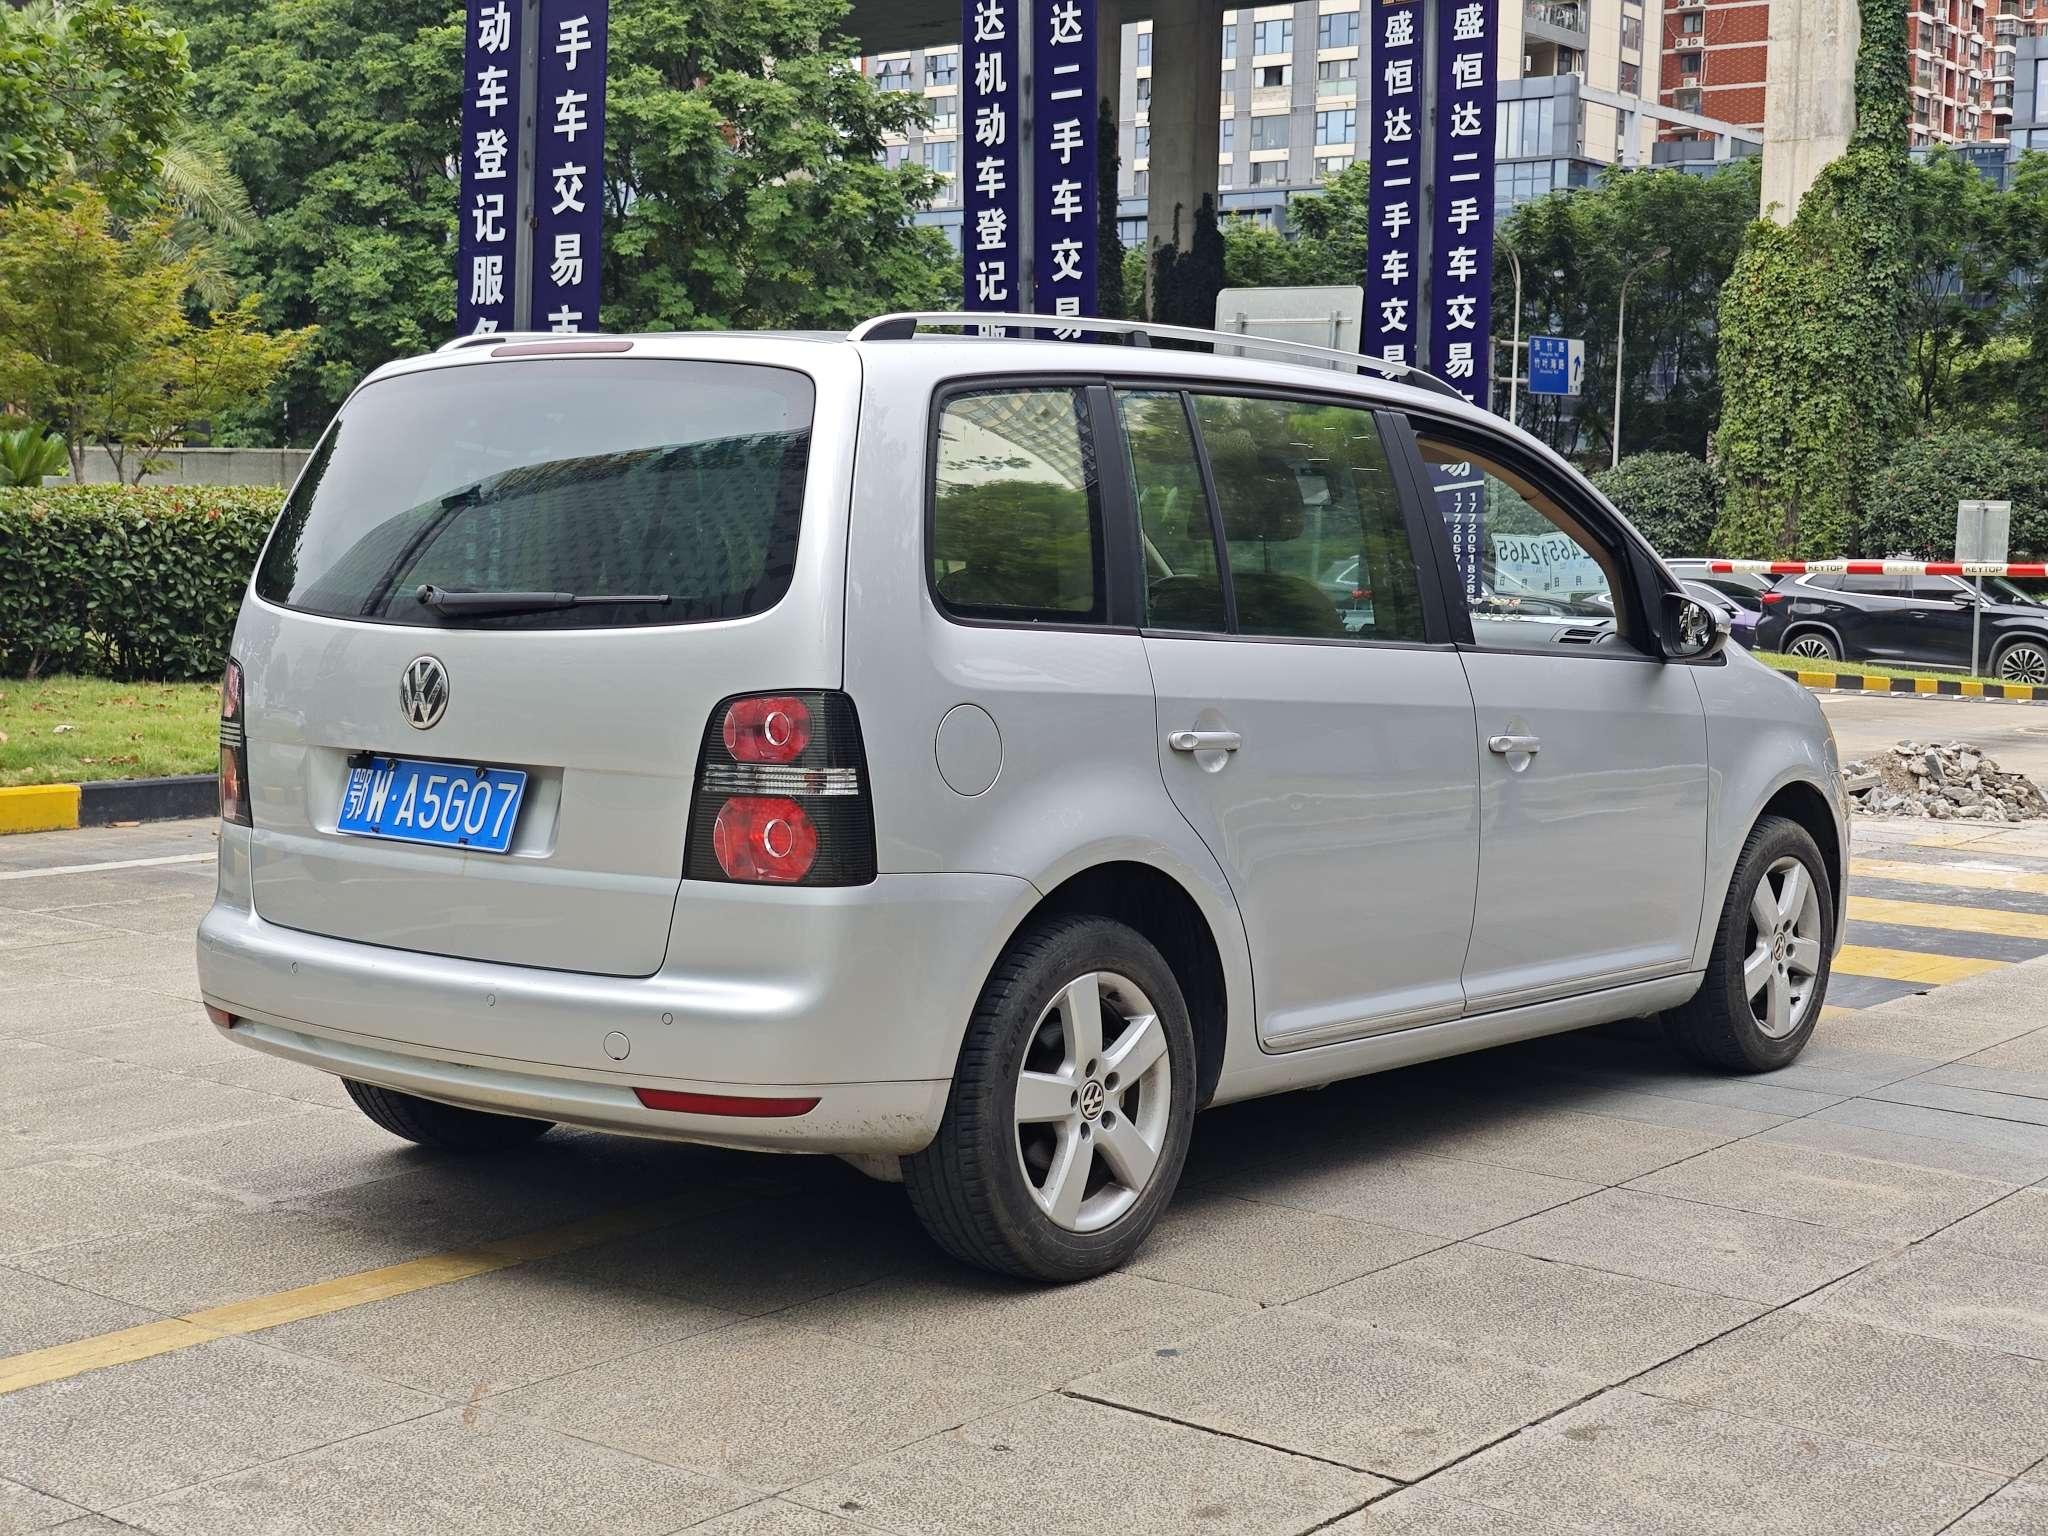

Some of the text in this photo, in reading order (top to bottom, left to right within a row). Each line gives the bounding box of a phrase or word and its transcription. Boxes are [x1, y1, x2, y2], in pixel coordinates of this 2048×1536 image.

[1445, 2, 1485, 401] 盛恒达二手车交易
[1808, 564, 1844, 573] KEYTOP
[1965, 566, 2003, 574] KEYTOP
